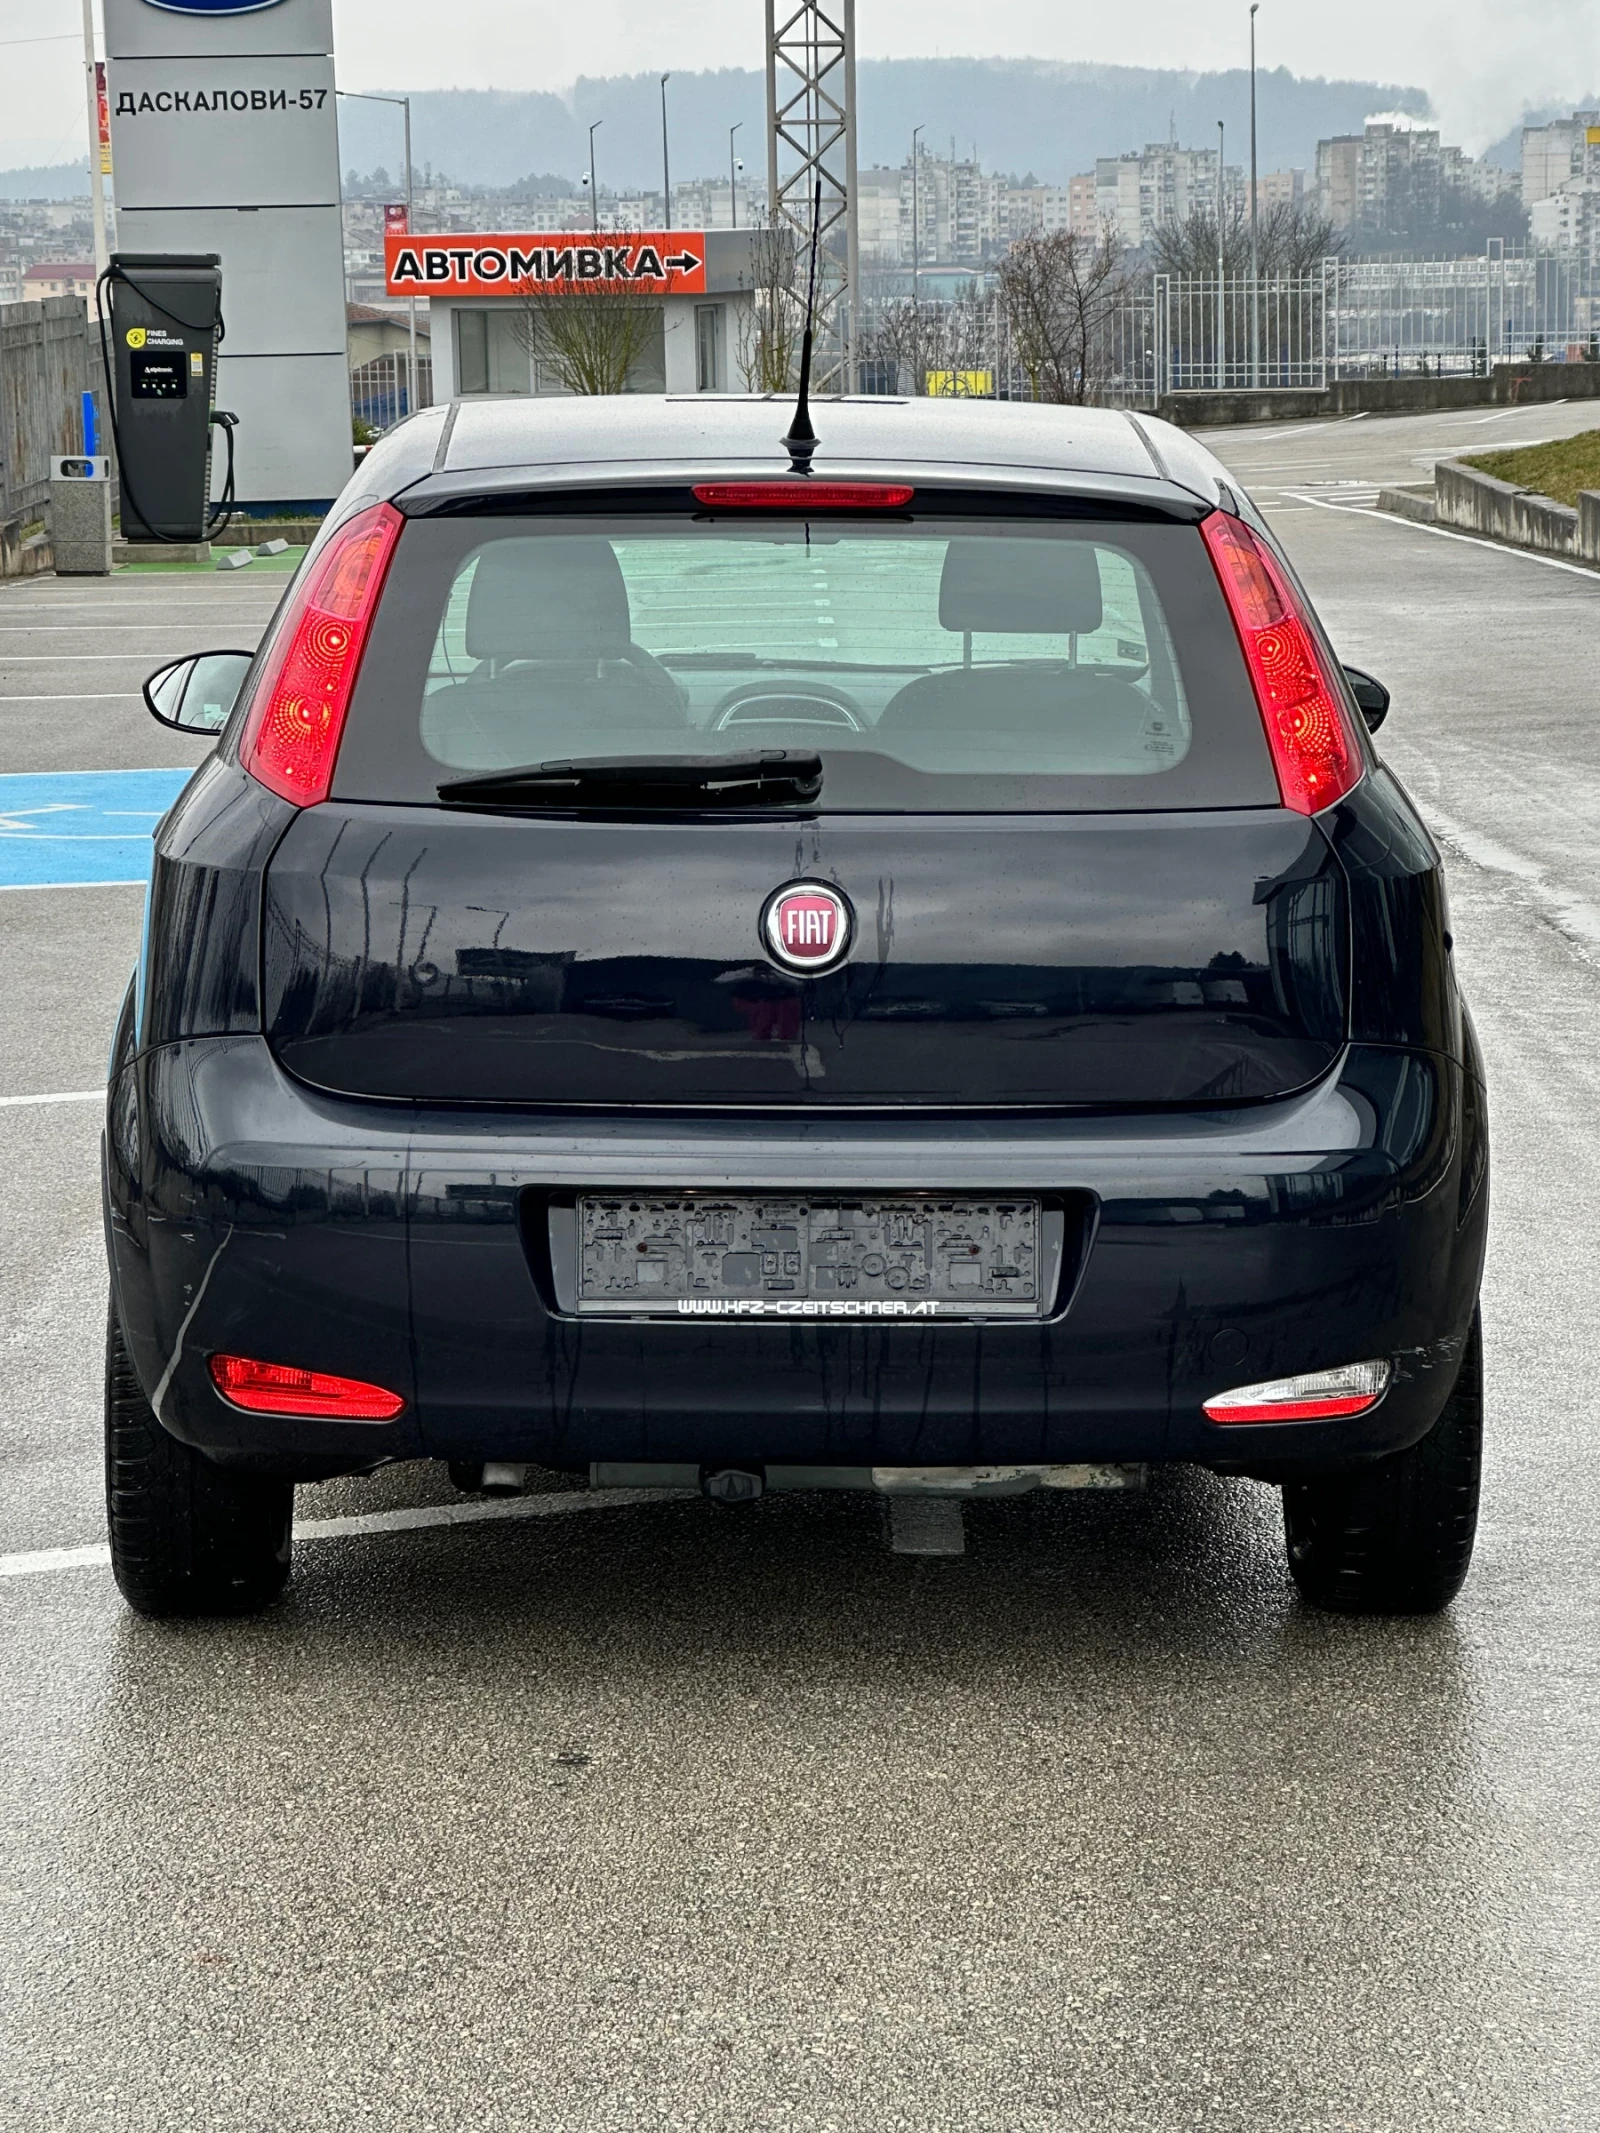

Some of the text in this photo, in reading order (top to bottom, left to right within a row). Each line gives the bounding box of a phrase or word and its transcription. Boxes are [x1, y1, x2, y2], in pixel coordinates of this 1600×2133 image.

[116, 89, 328, 116] ДАСКАЛОВИ-57
[392, 246, 666, 283] АВТОМИВКА
[147, 338, 184, 346] CHARGING
[787, 910, 832, 944] FIAT
